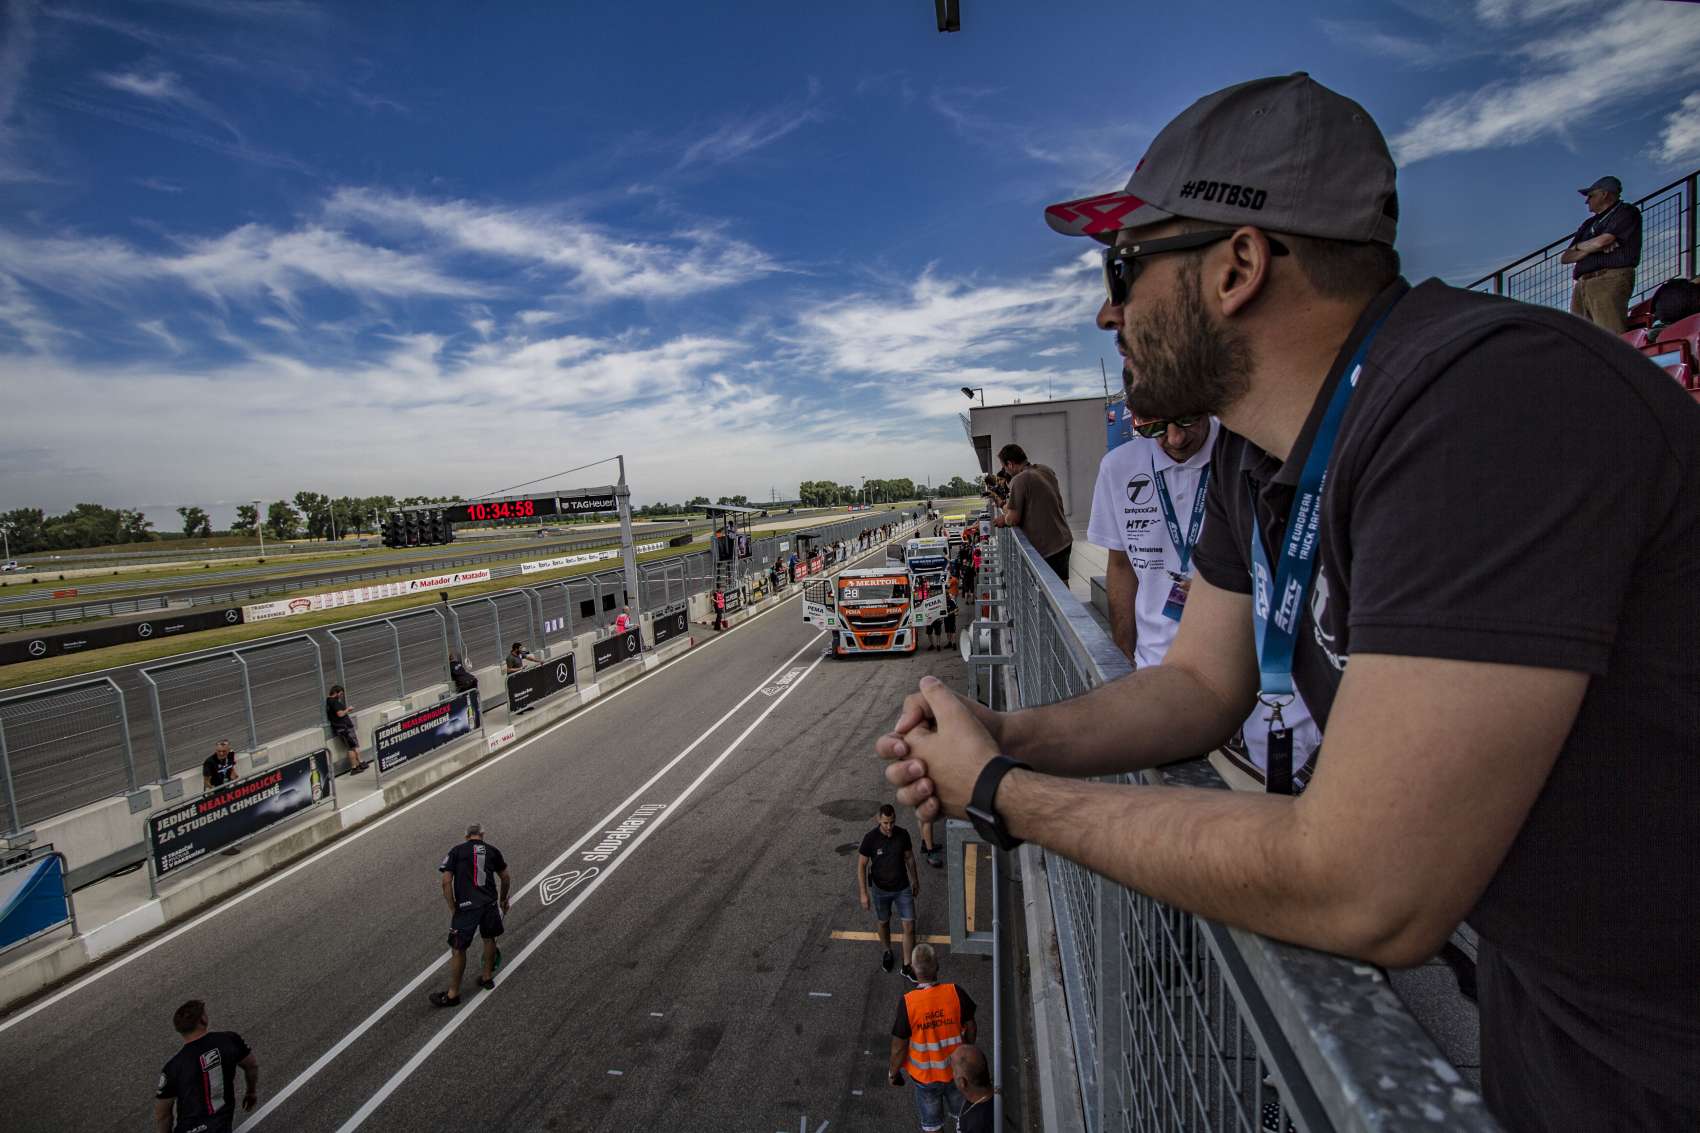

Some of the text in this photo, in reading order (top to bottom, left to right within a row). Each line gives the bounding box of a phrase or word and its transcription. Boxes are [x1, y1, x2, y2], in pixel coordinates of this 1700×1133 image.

[468, 501, 534, 521] 10:34:58
[1291, 492, 1312, 542] EUROPEAN
[1126, 519, 1150, 529] HTF
[1299, 532, 1315, 560] TRUCK
[420, 577, 450, 588] Matador
[462, 570, 488, 581] Matador
[855, 579, 898, 587] MERITOR
[844, 589, 858, 598] 28
[807, 605, 824, 614] PEMA
[925, 598, 942, 608] PEMA
[379, 723, 402, 740] JEDINÉ
[379, 739, 390, 750] ZA
[390, 726, 421, 746] STUDENA
[157, 770, 283, 832] JEDINÉ NEALKOHOLICKÉ
[158, 784, 280, 845] ZA STUDENA CHMELENÉ
